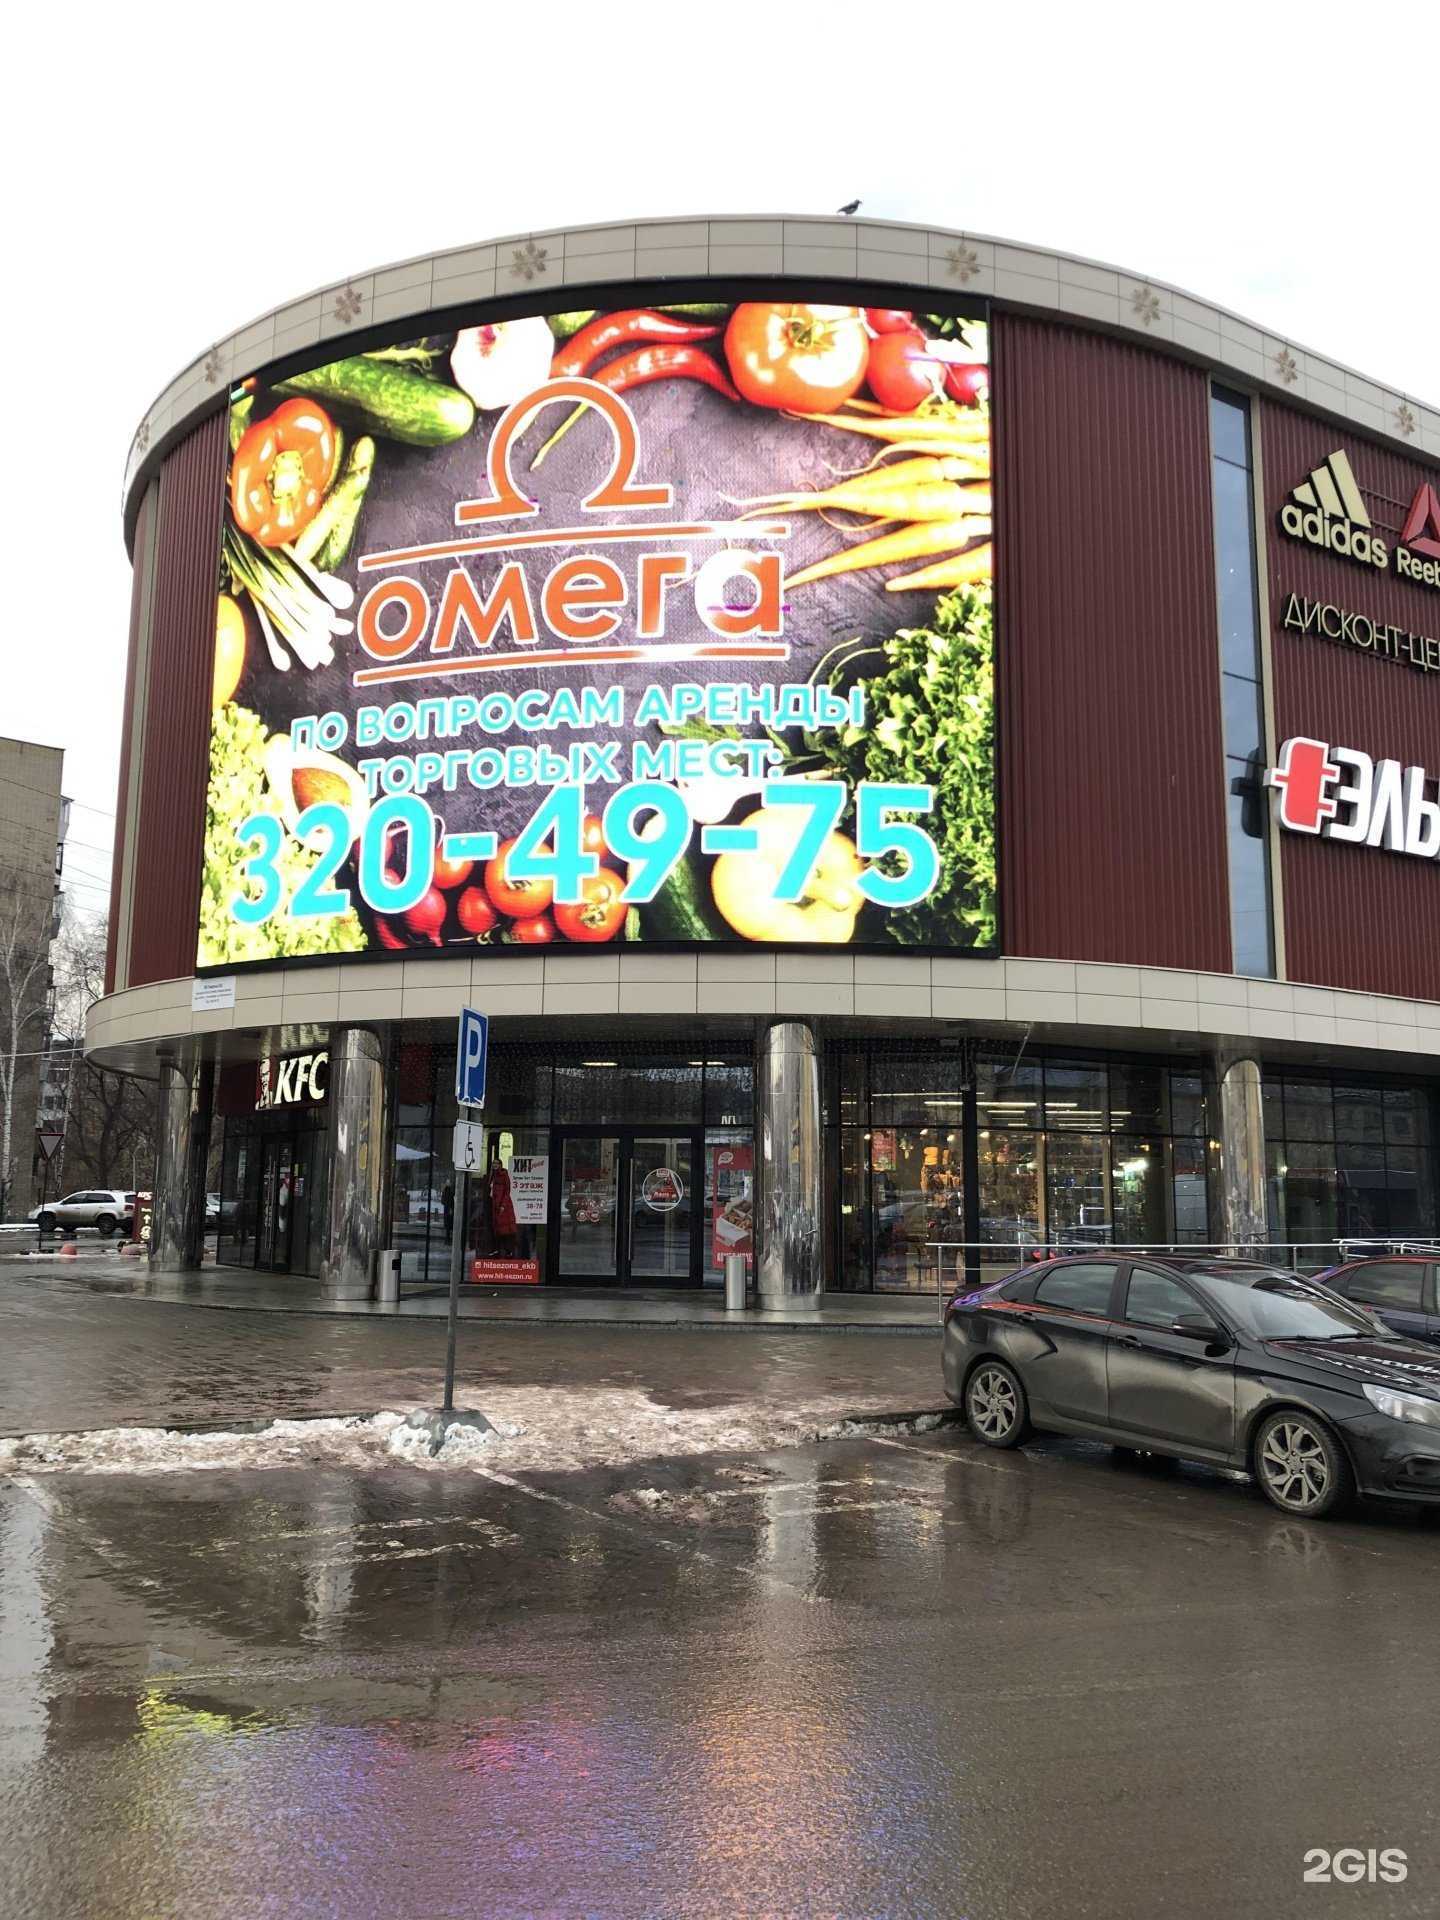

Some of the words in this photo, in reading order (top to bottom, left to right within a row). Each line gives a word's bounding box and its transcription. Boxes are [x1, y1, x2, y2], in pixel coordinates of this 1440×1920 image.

[1281, 502, 1389, 569] adidas
[357, 548, 785, 662] омега
[1285, 592, 1440, 672] ДИСКОНТ-ЦЕ
[290, 713, 348, 753] ПО
[355, 686, 624, 748] ВОПРОСАМ
[636, 683, 866, 729] АРЕНДЫ
[358, 741, 622, 798] ТОРГОВЫХ
[632, 738, 785, 785] МЕСТ:
[1328, 745, 1440, 860] ЭЛЬ
[230, 782, 941, 927] 320-49-75
[274, 1051, 329, 1105] KFC
